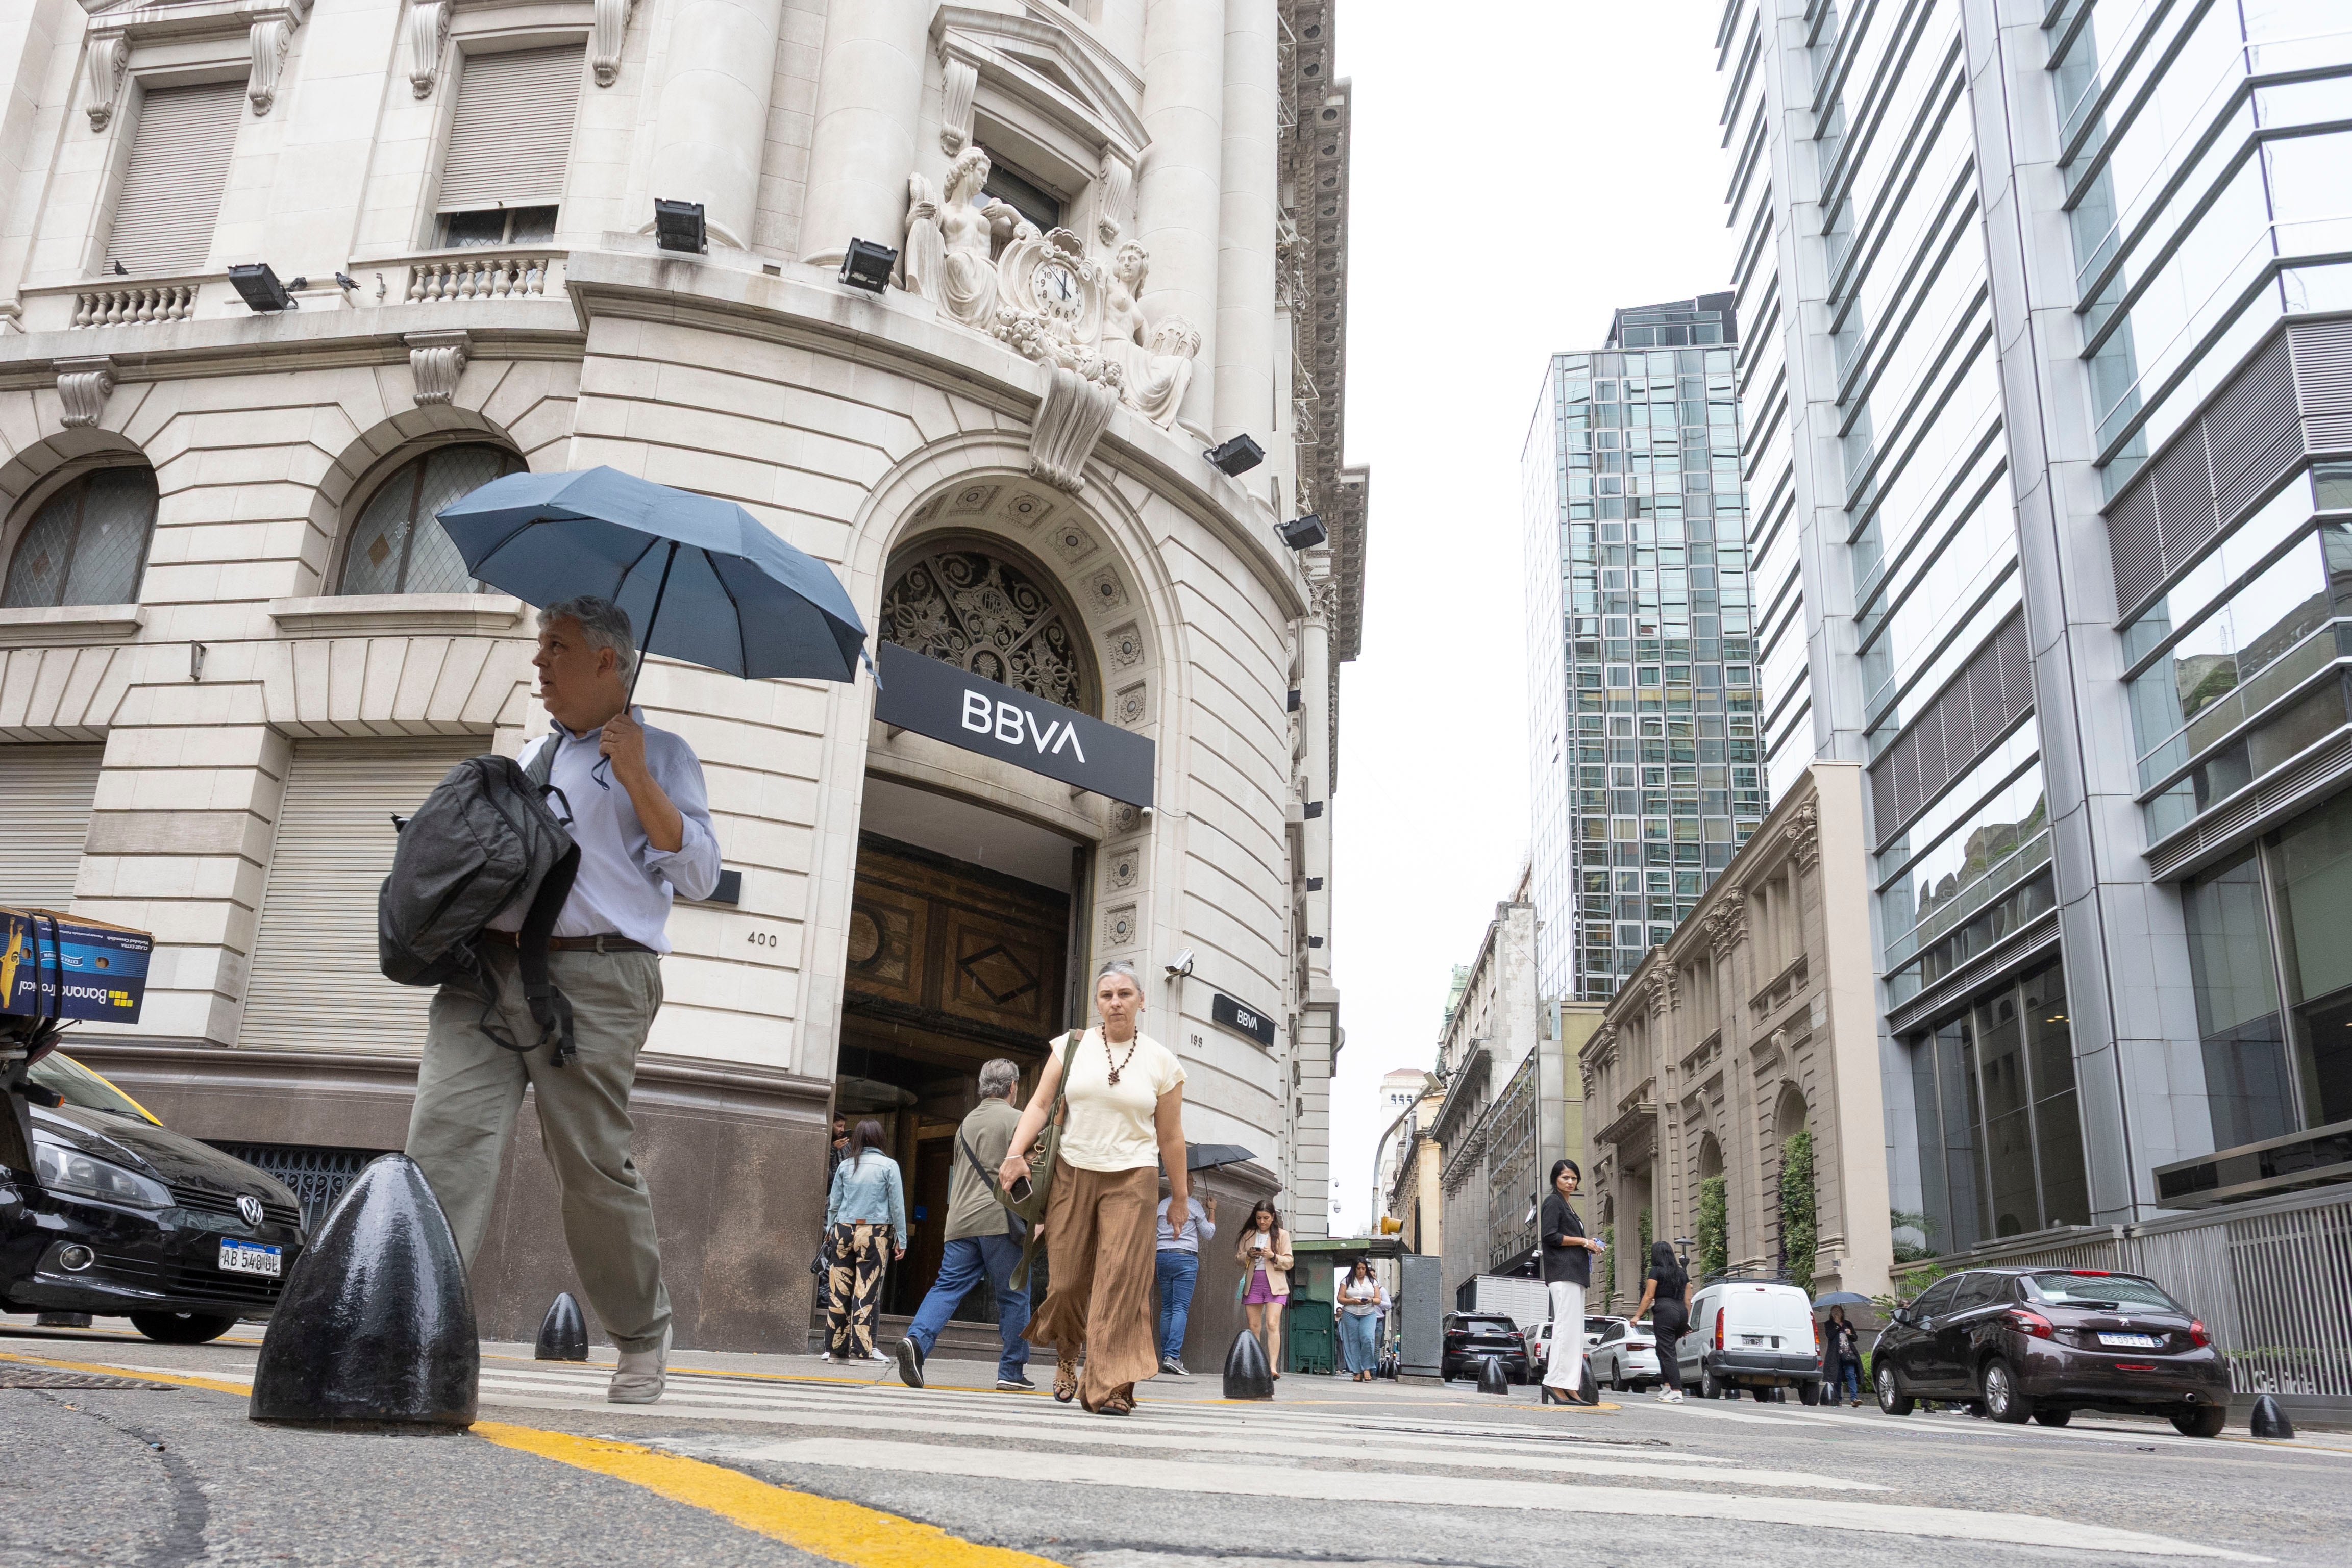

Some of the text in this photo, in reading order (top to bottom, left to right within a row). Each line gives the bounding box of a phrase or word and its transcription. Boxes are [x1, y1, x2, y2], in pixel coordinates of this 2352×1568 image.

[1040, 279, 1046, 287] 9
[1042, 290, 1047, 298] 8
[1048, 301, 1053, 309] 7
[1077, 298, 1080, 307] 3
[1055, 307, 1060, 315] 6
[1063, 310, 1069, 318] 5
[962, 689, 1085, 763] BBVA
[748, 931, 777, 947] 400
[1237, 1009, 1257, 1030] BBVA
[1191, 1033, 1203, 1048] 199
[223, 1249, 237, 1266] AB
[241, 1252, 261, 1270] 548
[2117, 1336, 2136, 1345] 091
